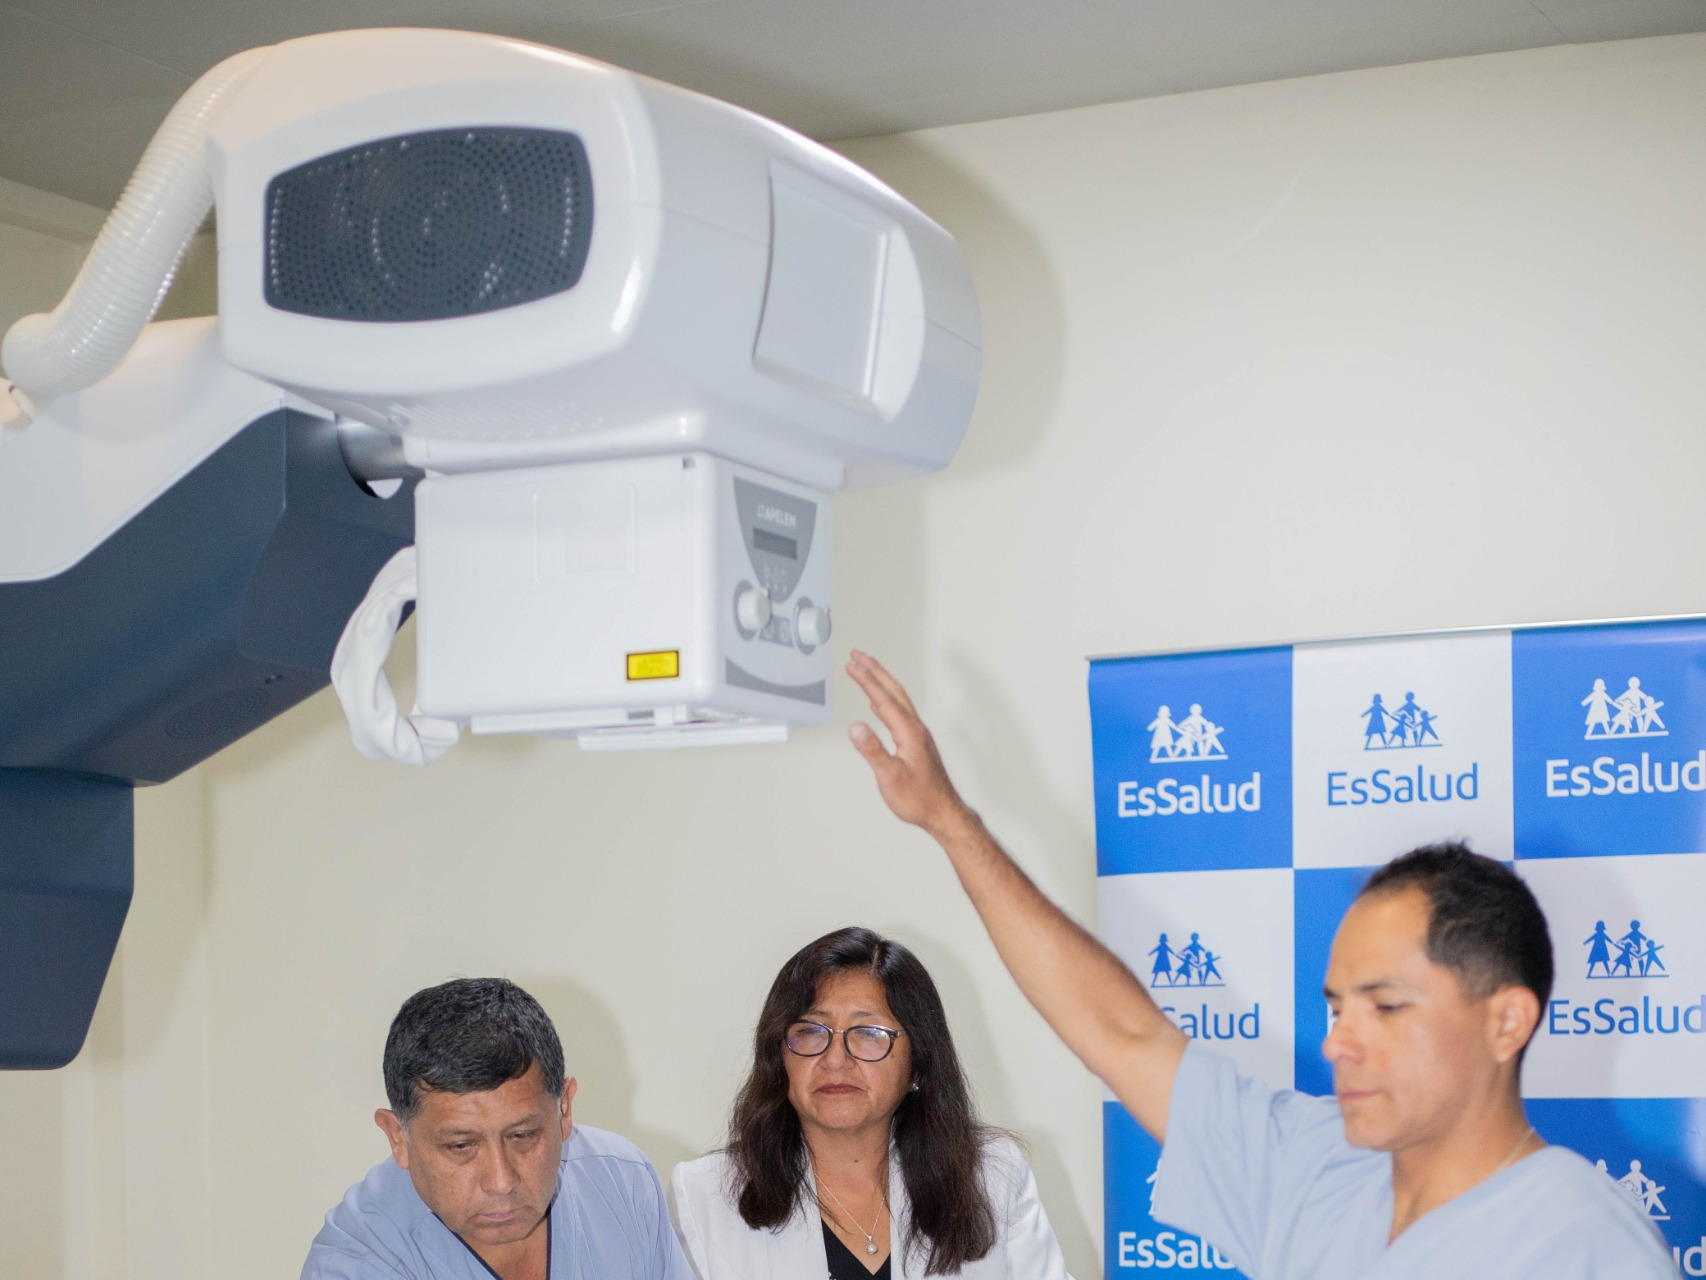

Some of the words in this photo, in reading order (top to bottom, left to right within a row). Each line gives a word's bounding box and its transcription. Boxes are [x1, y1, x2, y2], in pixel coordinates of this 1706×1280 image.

[1117, 771, 1261, 819] EsSalud
[1327, 761, 1479, 807] EsSalud
[1545, 749, 1706, 798] EsSalud
[1161, 1003, 1260, 1040] alud
[1549, 995, 1706, 1035] EsSalud
[1118, 1231, 1237, 1270] EsSalu
